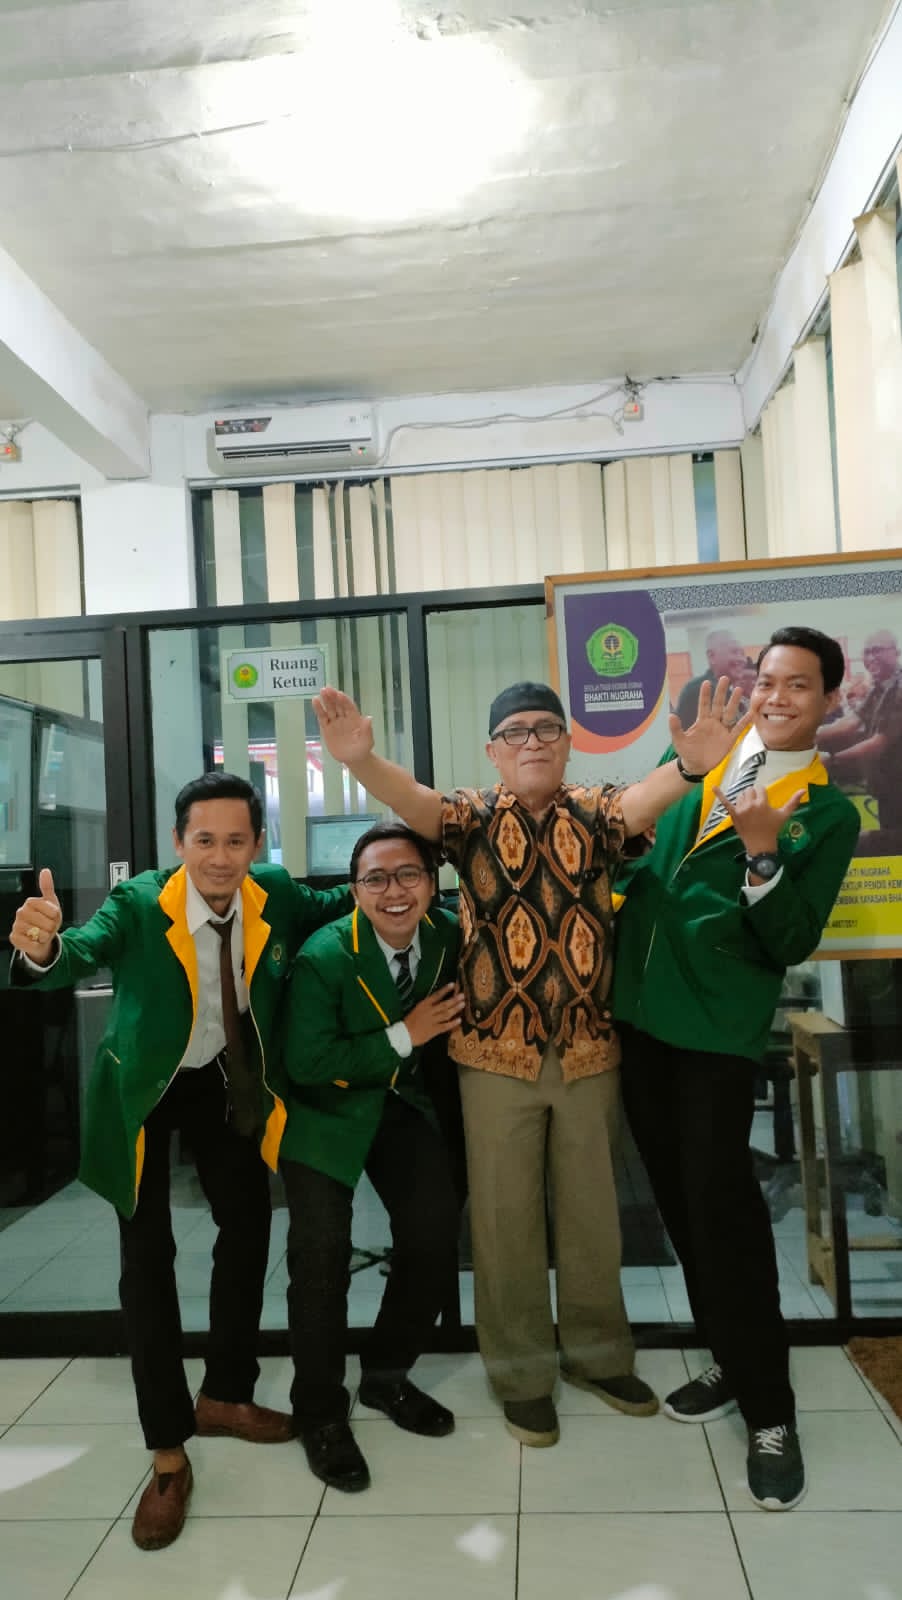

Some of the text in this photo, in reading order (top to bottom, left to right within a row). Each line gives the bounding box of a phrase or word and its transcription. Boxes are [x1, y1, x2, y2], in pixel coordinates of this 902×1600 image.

[270, 658, 318, 671] Ruang
[272, 676, 317, 689] Ketua
[584, 690, 644, 702] BHAKTI NUGRAHA
